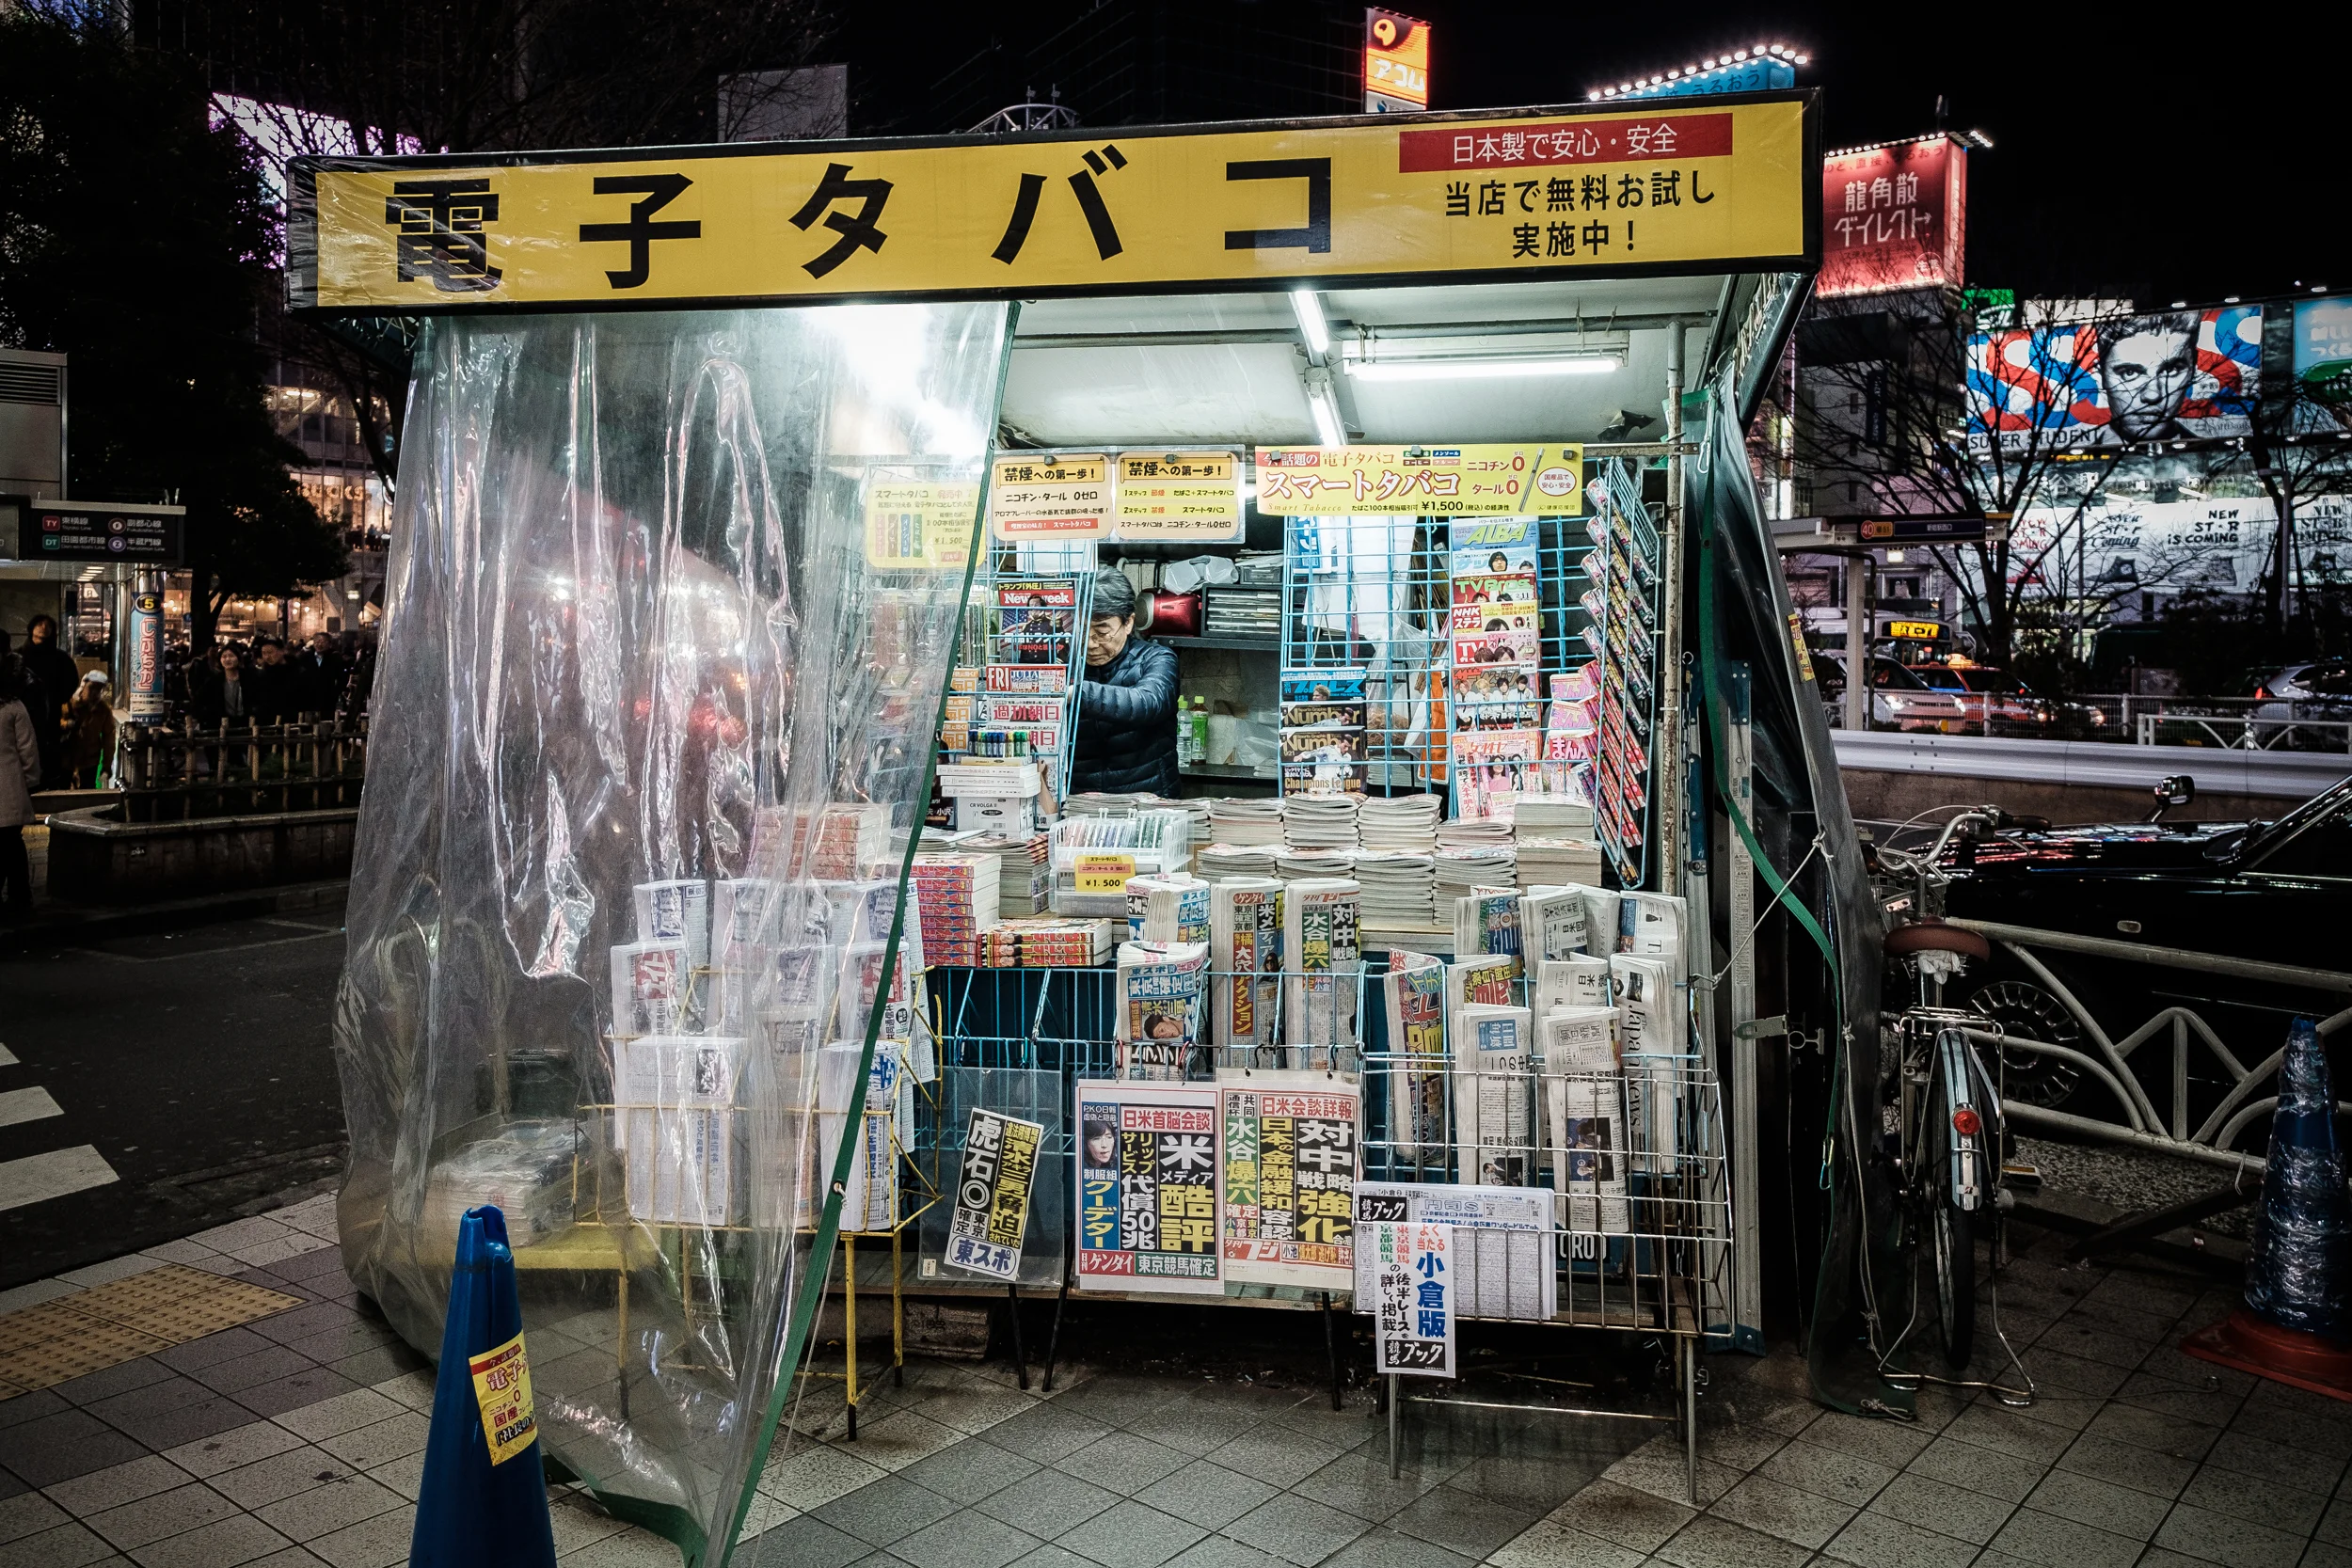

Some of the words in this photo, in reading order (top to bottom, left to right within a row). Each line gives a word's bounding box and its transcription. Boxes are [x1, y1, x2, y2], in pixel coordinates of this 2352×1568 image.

[1375, 58, 1425, 91] アコム
[1453, 123, 1678, 164] 日本製で安心・安全
[1445, 169, 1715, 217] 当店で無料お試し
[1845, 171, 1919, 212] 龍角散
[385, 142, 1331, 293] 電子タバコ
[1835, 208, 1931, 247] ダイレクト
[1512, 219, 1635, 259] 実施中！
[1128, 461, 1222, 477] 禁煙への第一歩！
[1322, 452, 1395, 467] 電子タバコ
[1467, 461, 1510, 471] ニコチン
[1512, 456, 1525, 471] 0
[1004, 467, 1095, 482] 禁煙への第一歩！
[1263, 469, 1460, 501] スマートタバコ
[1005, 492, 1068, 503] ニコチン・タール
[1472, 484, 1504, 495] タール
[1506, 480, 1519, 495] 0
[1183, 506, 1225, 515] スマートタバコ
[1267, 503, 1298, 512] Smart
[1303, 503, 1343, 512] Tabacco
[1421, 500, 1464, 513] ¥1,500
[2209, 509, 2240, 519] NEW
[61, 516, 88, 525] 東横線
[127, 519, 162, 528] 副都心線
[1053, 520, 1092, 529] スマートタバコ
[1862, 524, 1874, 534] 40
[61, 536, 105, 545] 田園都市線
[1454, 579, 1484, 594] TV
[144, 598, 154, 610] 5
[1454, 607, 1480, 616] NHK
[1454, 619, 1481, 629] ステラ
[988, 667, 1009, 691] FRI
[993, 705, 1059, 721] 週刊朝日
[1284, 707, 1360, 725] Numbr
[1283, 734, 1360, 752] Numbr
[1234, 906, 1253, 914] 東京
[1543, 901, 1579, 919] 日本経済新聞
[1258, 904, 1276, 958] 米メディア
[1332, 904, 1356, 947] 対中
[1303, 913, 1329, 968] 水谷爆穴
[1332, 946, 1357, 960] 戦略
[1128, 974, 1184, 998] 東京日曜確定
[885, 1003, 896, 1039] 共同通信杯
[1489, 1022, 1514, 1035] 毎日
[1489, 1035, 1515, 1048] 新聞
[1560, 1024, 1601, 1041] 朝日新聞
[1622, 1005, 1645, 1066] Japan
[1084, 1104, 1117, 1115] PKO日報
[1228, 1095, 1240, 1117] 通信杯
[1243, 1095, 1255, 1117] 共同
[1262, 1097, 1352, 1119] 日米会談詳報
[1629, 1073, 1645, 1127] News
[1123, 1110, 1211, 1131] 日米首脳会談
[965, 1117, 1001, 1182] 虎石
[1121, 1132, 1136, 1175] サービス
[1140, 1132, 1155, 1172] リップ
[1160, 1134, 1214, 1170] 米
[1297, 1119, 1352, 1172] 対中
[997, 1138, 1034, 1196] 清水アキラ三男
[1226, 1118, 1258, 1204] 水谷爆穴
[1084, 1168, 1118, 1180] 制服組
[1160, 1171, 1214, 1185] メディア
[1261, 1117, 1294, 1240] 日本の金融緩和容認
[1297, 1171, 1354, 1191] 戦略
[956, 1208, 970, 1233] 確定
[993, 1195, 1023, 1236] 脅迫
[1084, 1180, 1117, 1248] クーデター
[1121, 1174, 1156, 1250] 代償50兆
[1159, 1184, 1215, 1252] 酷評
[1226, 1205, 1257, 1218] 確定
[1298, 1189, 1352, 1243] 強化
[1372, 1200, 1406, 1221] ブック
[972, 1212, 987, 1238] 東京
[1236, 1219, 1247, 1237] 京都
[1248, 1219, 1257, 1238] 東京
[1420, 1225, 1440, 1237] よく
[989, 1232, 1021, 1248] されていた
[1379, 1225, 1393, 1264] 京都競馬
[1396, 1225, 1410, 1264] 東京競馬
[1417, 1238, 1446, 1251] 当たる
[955, 1239, 1010, 1272] 東スポ
[1283, 1244, 1297, 1259] 小池
[1089, 1254, 1133, 1273] ゲンダイ
[1138, 1256, 1216, 1276] 東京競馬確定
[1391, 1264, 1401, 1273] の
[1396, 1273, 1411, 1338] 後半レースを
[1416, 1252, 1446, 1338] 小倉版
[1380, 1274, 1397, 1339] 詳しく掲載！
[1388, 1340, 1400, 1365] 競馬
[1401, 1342, 1443, 1364] ブック
[489, 1401, 514, 1415] ニコチン
[494, 1406, 518, 1428] 国産
